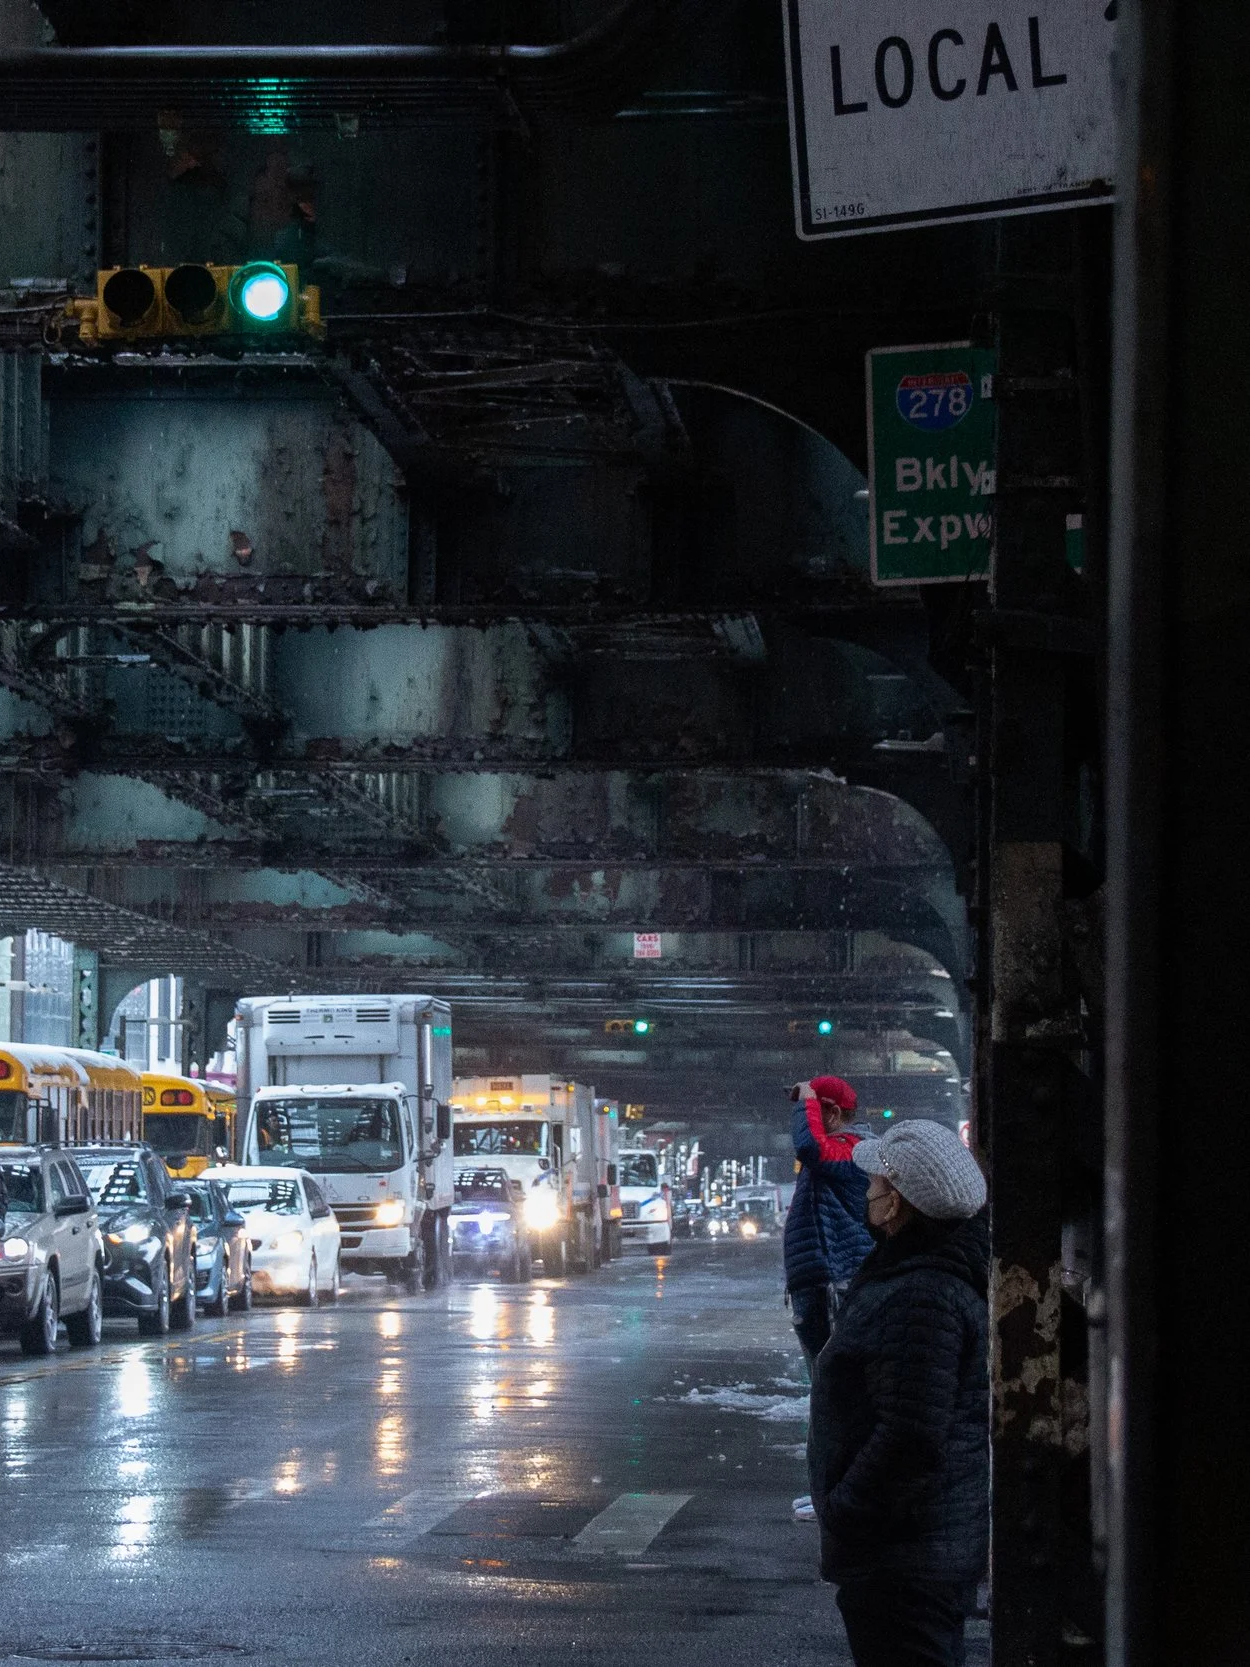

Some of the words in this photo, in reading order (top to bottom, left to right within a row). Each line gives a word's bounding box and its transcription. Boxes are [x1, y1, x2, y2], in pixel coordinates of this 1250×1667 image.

[830, 16, 1067, 116] LOCAL
[908, 386, 967, 419] 278
[895, 455, 988, 497] Bkly
[883, 510, 992, 550] Expw
